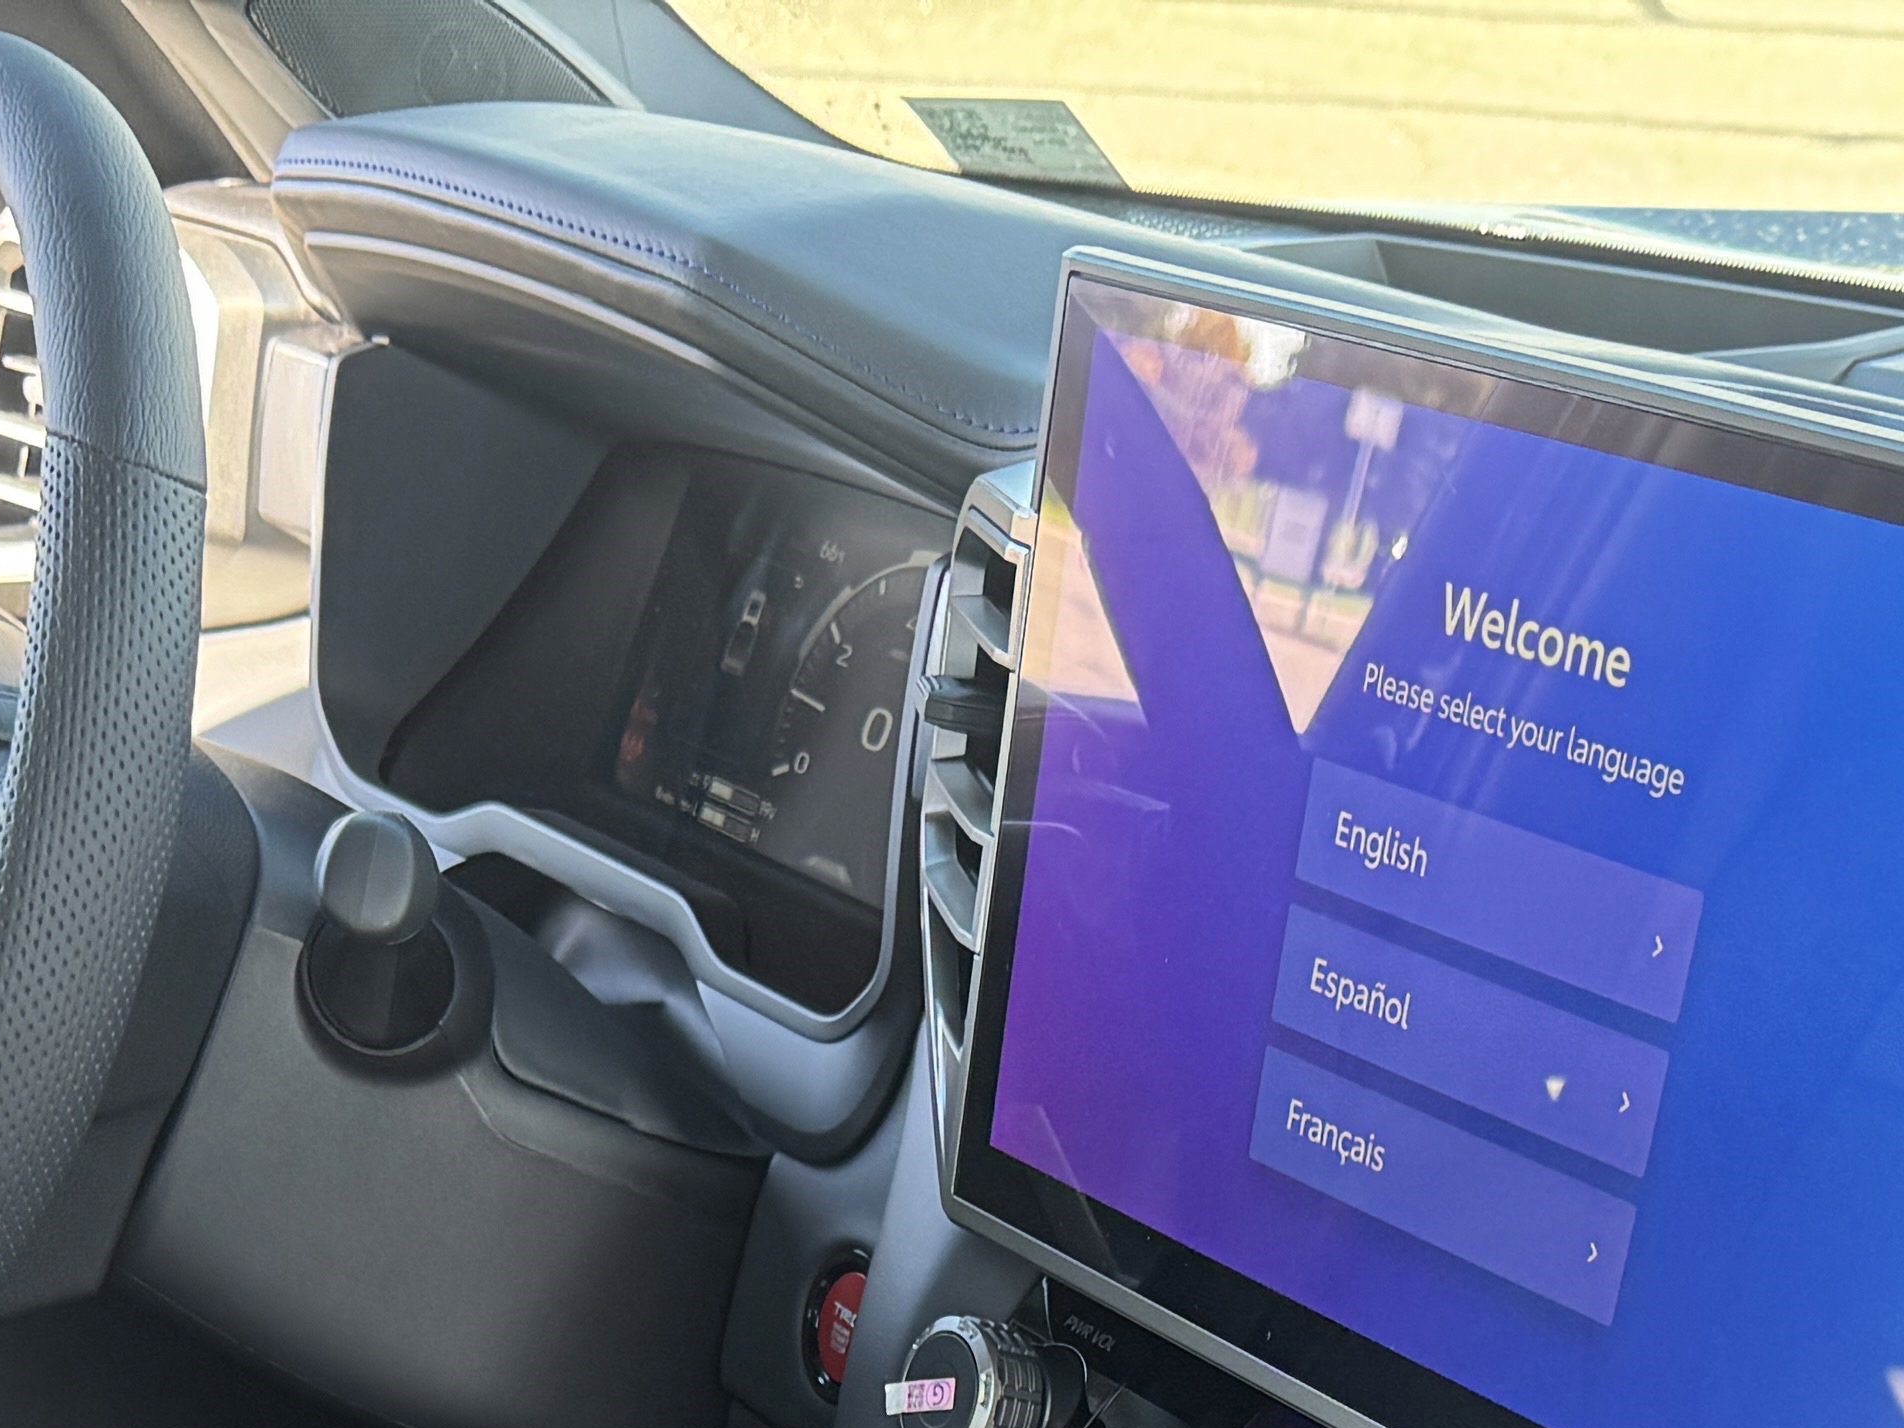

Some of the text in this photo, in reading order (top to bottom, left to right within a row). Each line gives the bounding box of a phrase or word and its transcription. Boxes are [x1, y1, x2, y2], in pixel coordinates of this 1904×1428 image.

[836, 645, 853, 668] 2
[1444, 582, 1632, 688] Welcome
[794, 752, 810, 774] 0
[861, 707, 894, 752] 0
[1363, 663, 1685, 799] Please select your language
[1335, 811, 1428, 878] English
[1310, 957, 1410, 1030] Español
[1286, 1098, 1386, 1172] Français
[1064, 1314, 1116, 1352] PWR VOL
